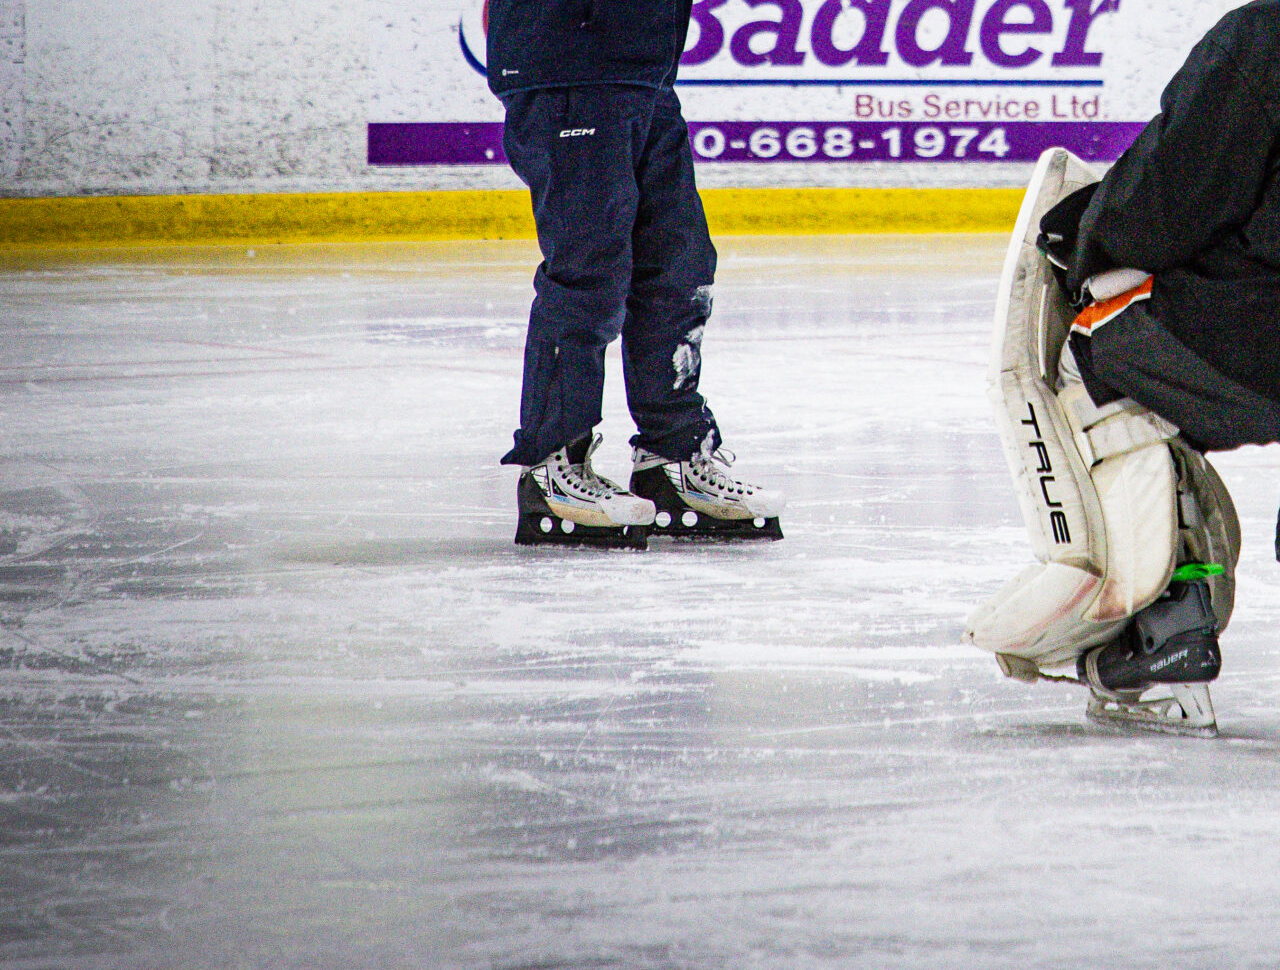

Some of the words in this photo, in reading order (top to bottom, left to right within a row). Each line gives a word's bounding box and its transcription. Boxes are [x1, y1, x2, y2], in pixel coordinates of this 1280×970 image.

[854, 94, 913, 119] Bus
[923, 94, 1040, 119] Service
[559, 127, 596, 138] CCM
[1020, 401, 1072, 545] TRUE
